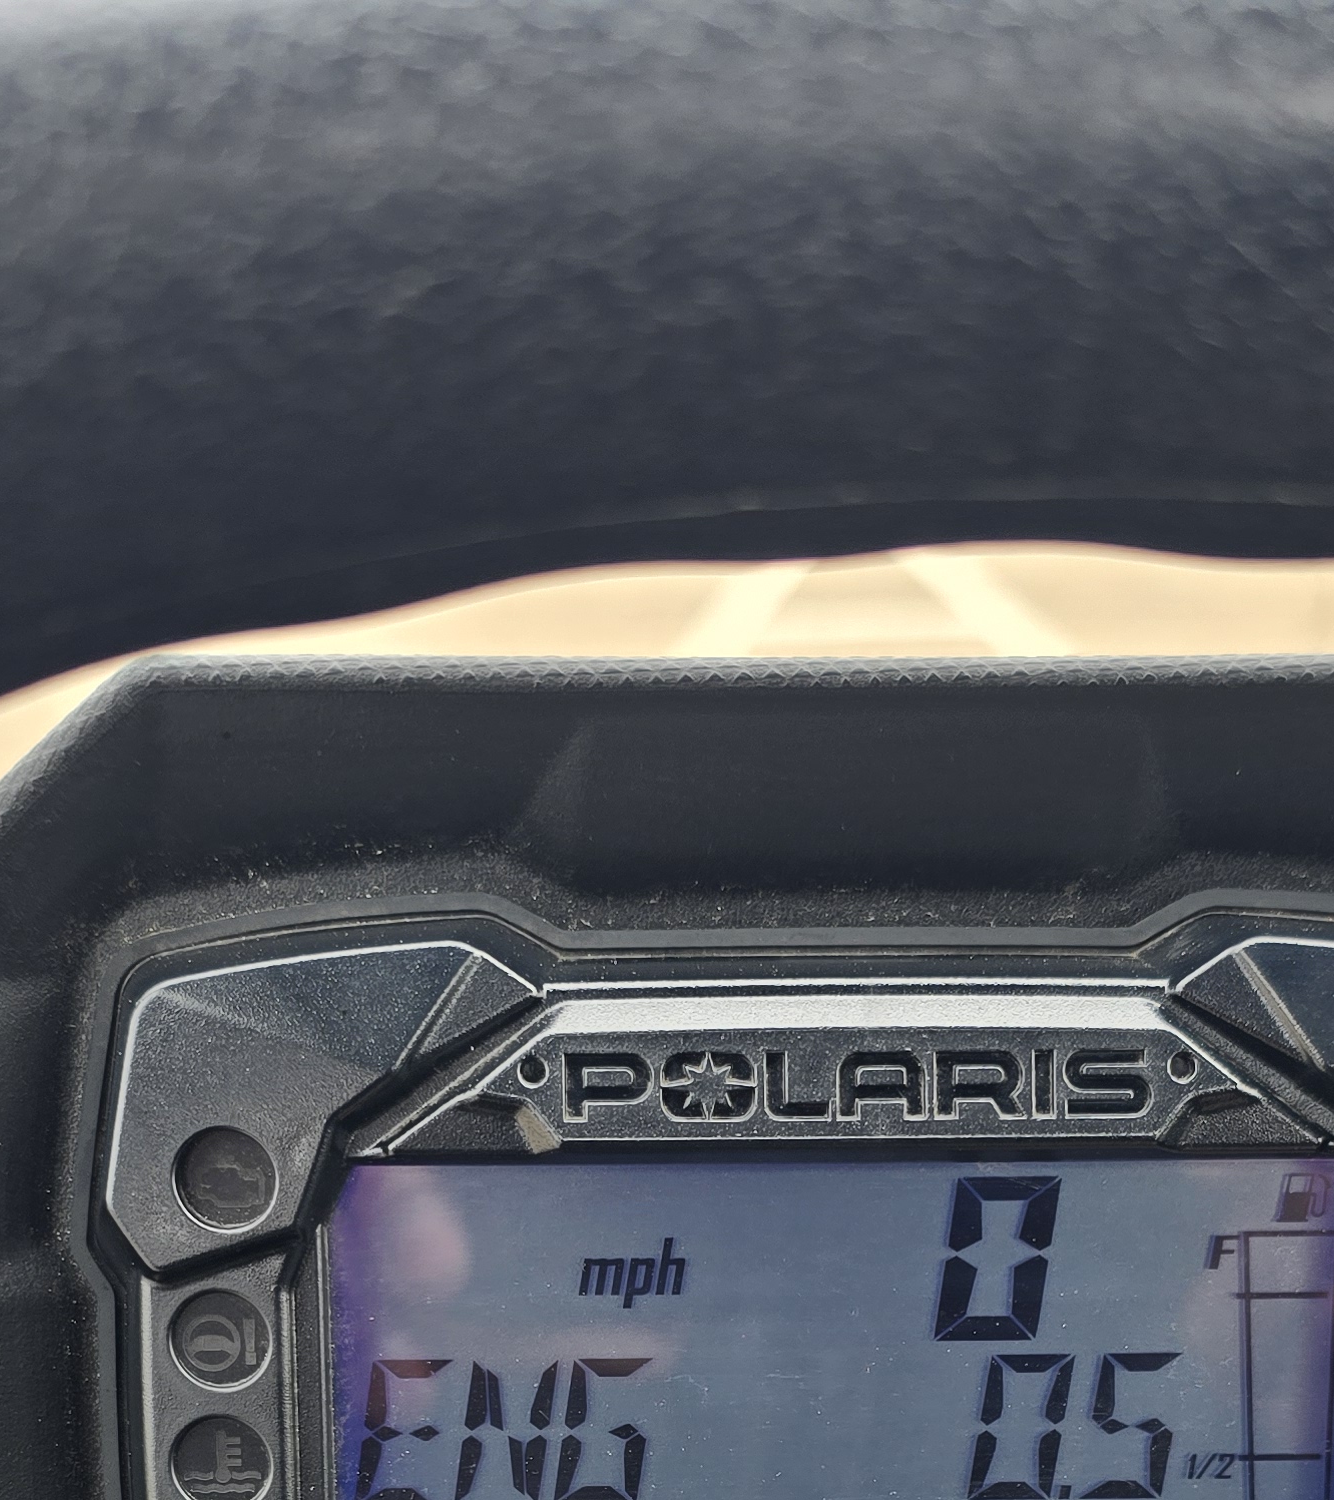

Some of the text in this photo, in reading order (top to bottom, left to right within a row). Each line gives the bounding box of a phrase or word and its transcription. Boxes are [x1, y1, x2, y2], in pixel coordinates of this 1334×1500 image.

[563, 1049, 1154, 1123] POLARIS
[578, 1237, 686, 1310] mph
[933, 1175, 1063, 1342] 0
[1207, 1234, 1240, 1271] F
[967, 1352, 1183, 1500] 0.5
[1186, 1452, 1236, 1480] 1/2
